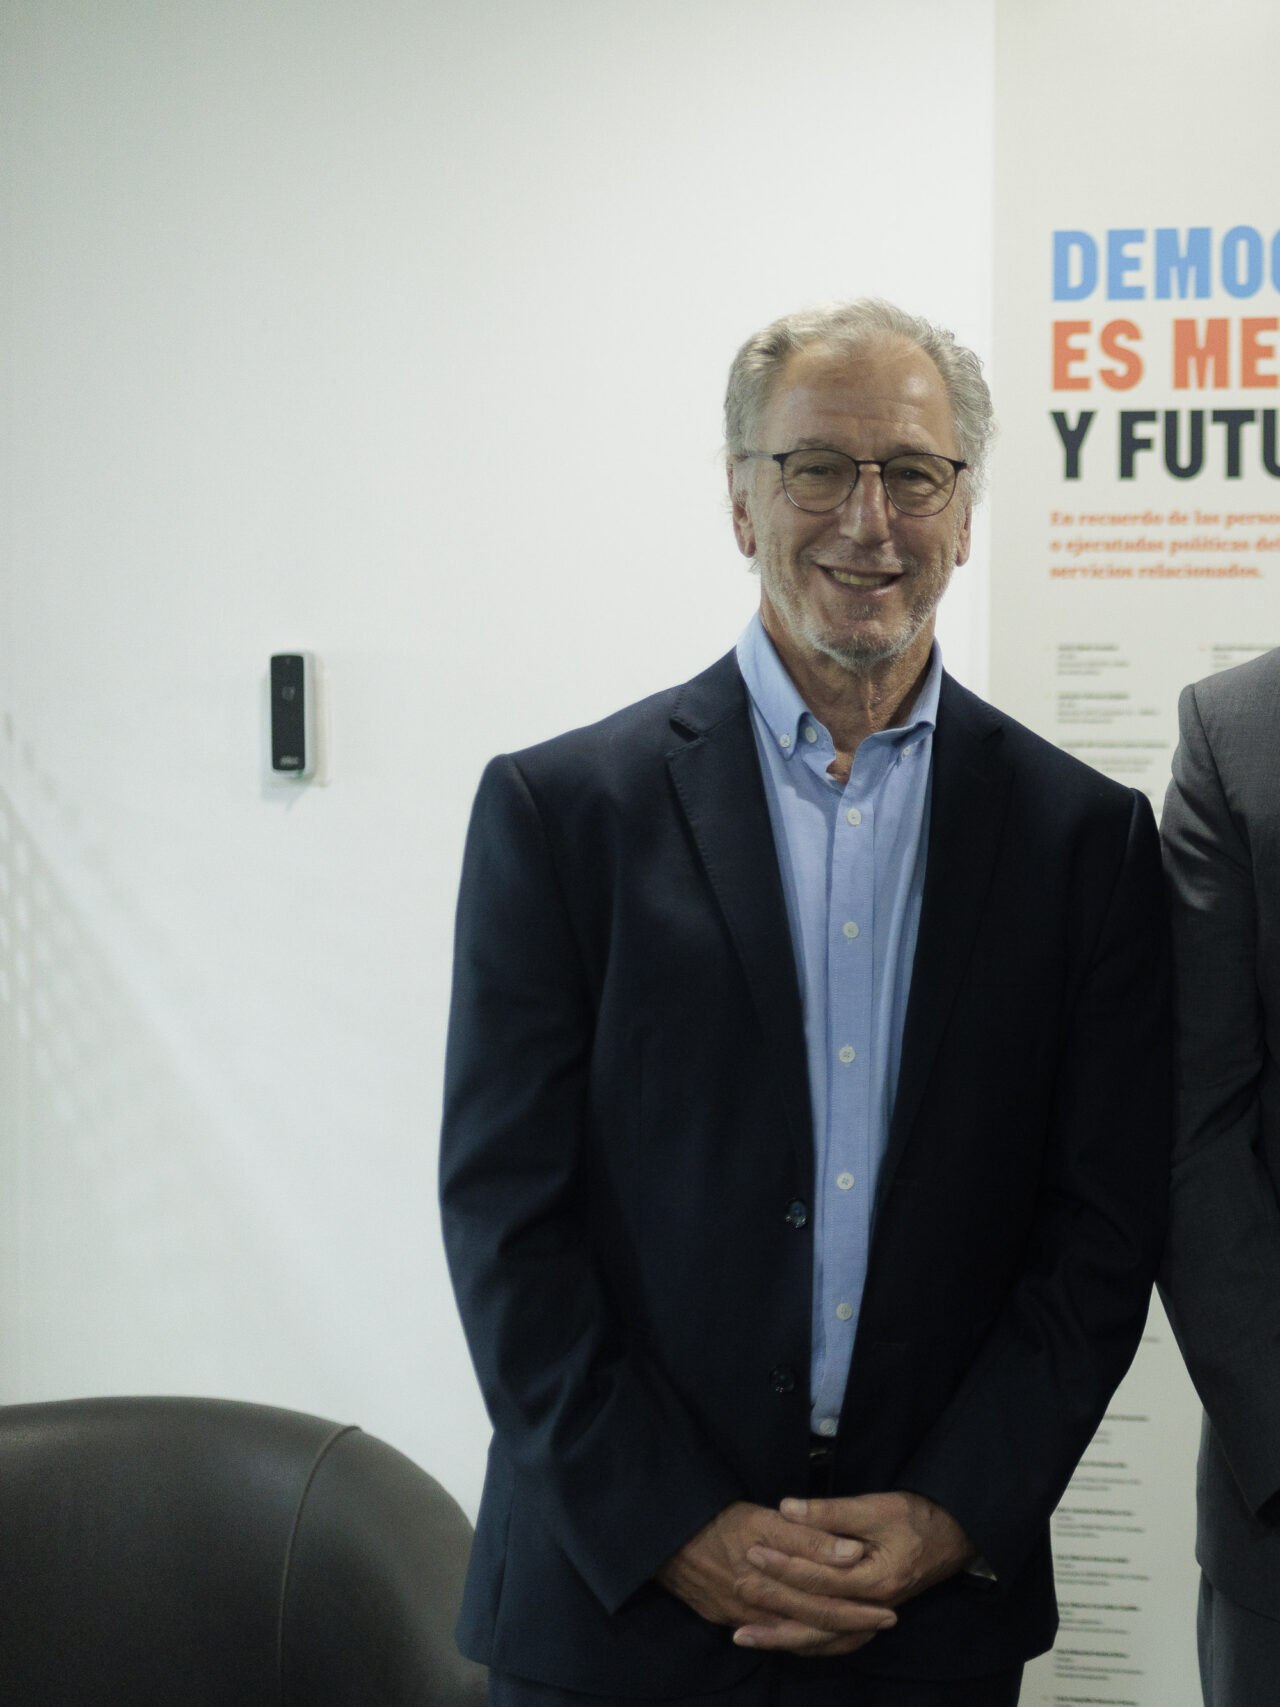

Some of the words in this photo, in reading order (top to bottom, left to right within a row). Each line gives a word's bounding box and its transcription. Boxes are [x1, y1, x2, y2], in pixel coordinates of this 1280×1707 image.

[1052, 318, 1145, 392] ES
[1051, 409, 1097, 480] Y
[1079, 509, 1163, 525] recuerdo
[1168, 509, 1189, 525] de
[1194, 508, 1220, 525] las
[1050, 563, 1133, 578] servicios
